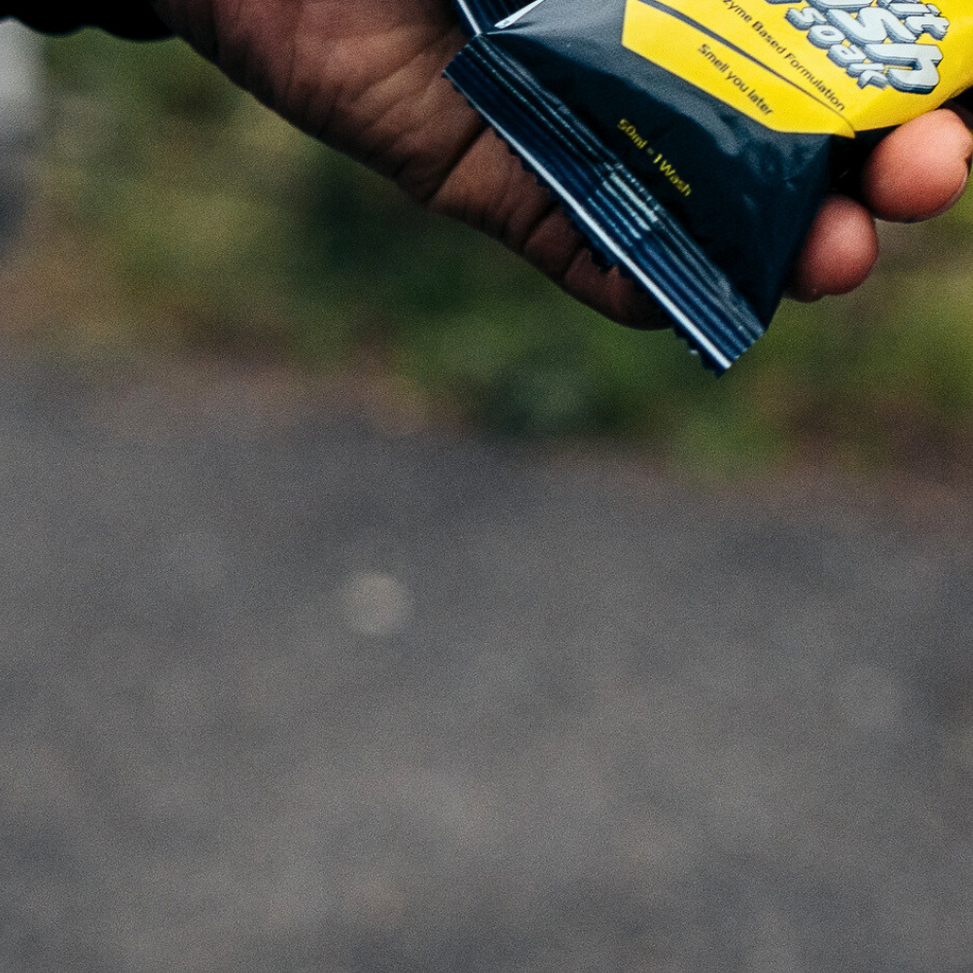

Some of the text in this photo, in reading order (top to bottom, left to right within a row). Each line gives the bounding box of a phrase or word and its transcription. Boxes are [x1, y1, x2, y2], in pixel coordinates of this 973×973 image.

[697, 43, 773, 116] Smell you later
[751, 20, 786, 54] Based
[784, 52, 846, 112] Formulation
[784, 6, 888, 89] soak
[618, 118, 648, 149] 50ml
[659, 159, 691, 196] Wash
